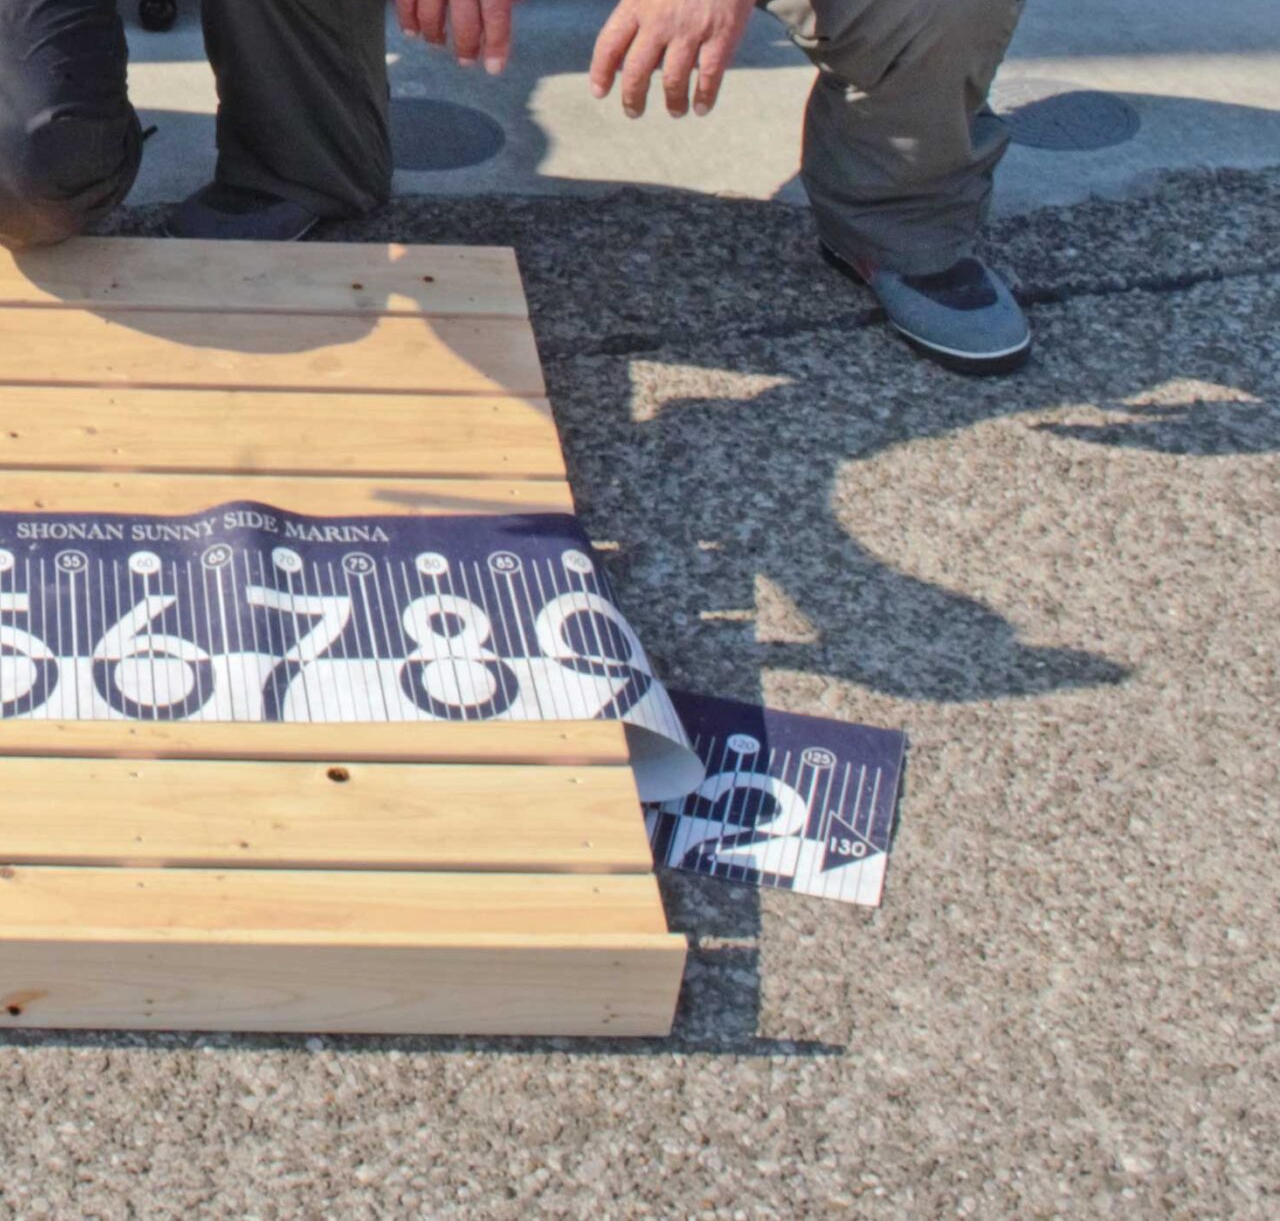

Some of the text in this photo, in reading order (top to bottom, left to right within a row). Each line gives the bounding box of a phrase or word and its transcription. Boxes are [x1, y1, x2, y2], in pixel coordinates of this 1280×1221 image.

[15, 509, 391, 543] SHONAN SUNNY SIDE MARINA
[61, 555, 83, 569] 55
[135, 556, 154, 569] 60
[207, 549, 227, 565] 65
[348, 557, 369, 571] 75
[422, 557, 441, 570] 80
[494, 556, 514, 570] 85
[92, 595, 217, 720] 6
[245, 585, 352, 723] 7
[399, 593, 520, 721] 8
[535, 591, 653, 719] 9
[807, 750, 831, 765] 125
[829, 836, 867, 858] 130
